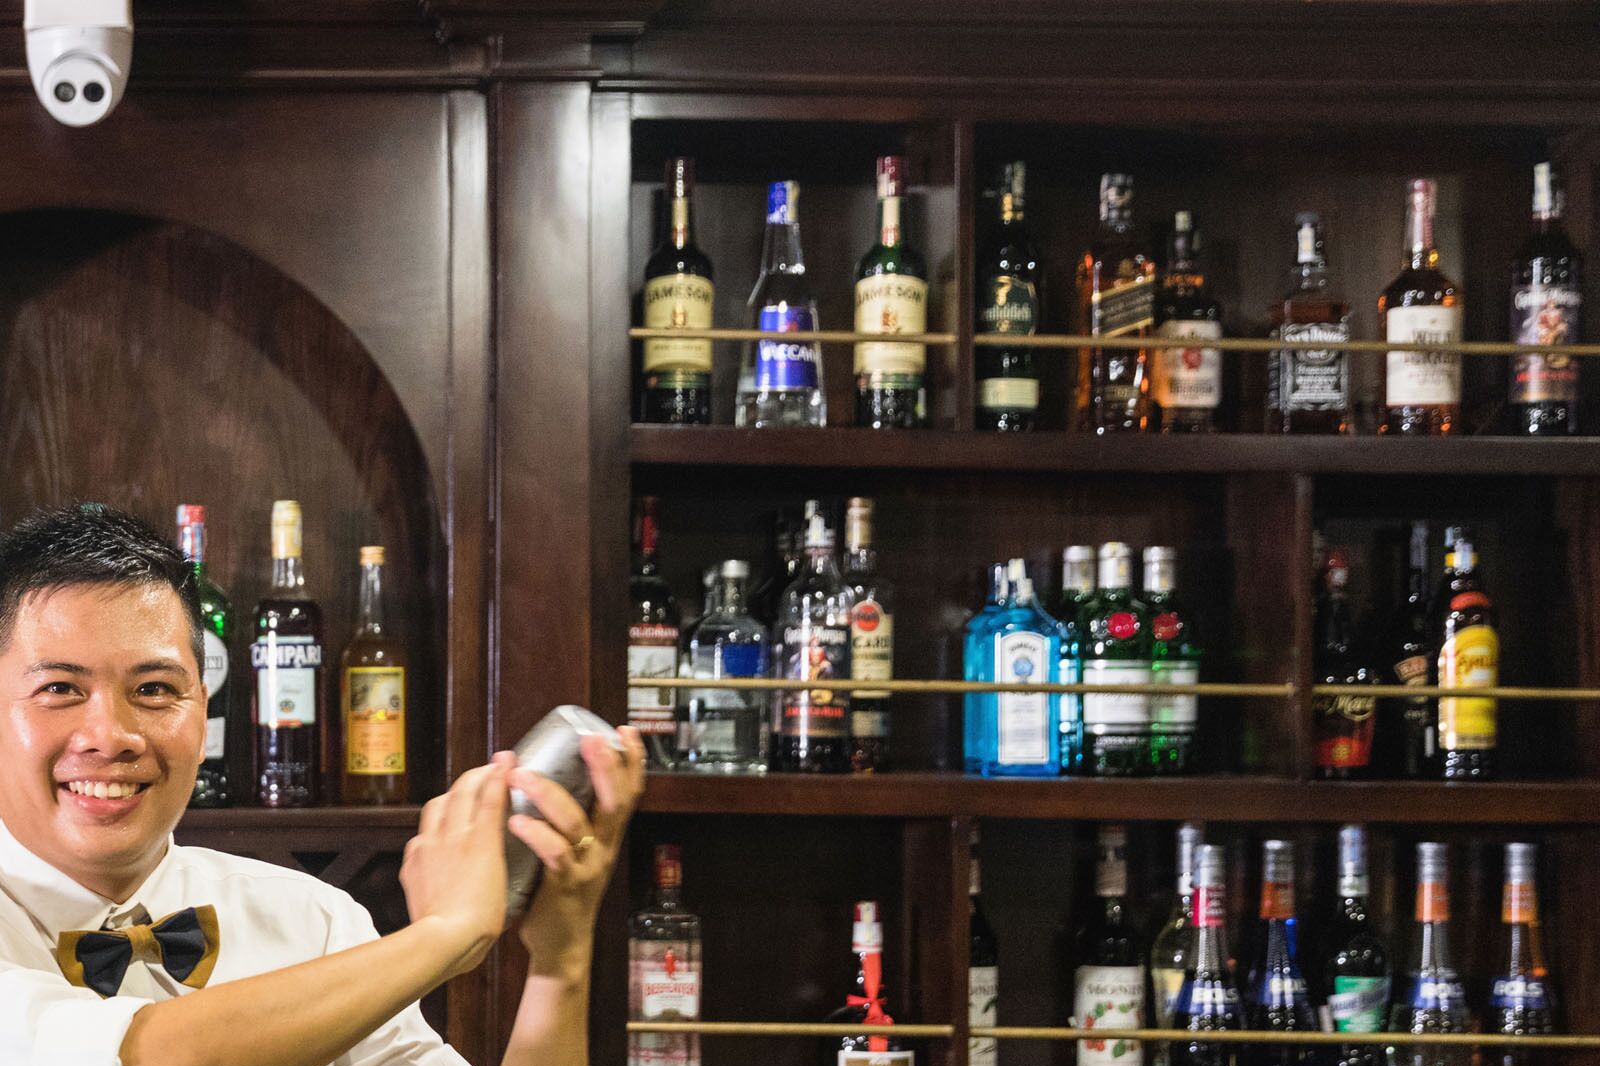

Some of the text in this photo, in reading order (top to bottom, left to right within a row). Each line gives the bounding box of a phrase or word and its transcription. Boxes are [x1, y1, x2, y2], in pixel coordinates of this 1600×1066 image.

[251, 643, 322, 668] CAMPARI
[1191, 987, 1240, 1004] BOLS
[1493, 980, 1544, 998] BOLS
